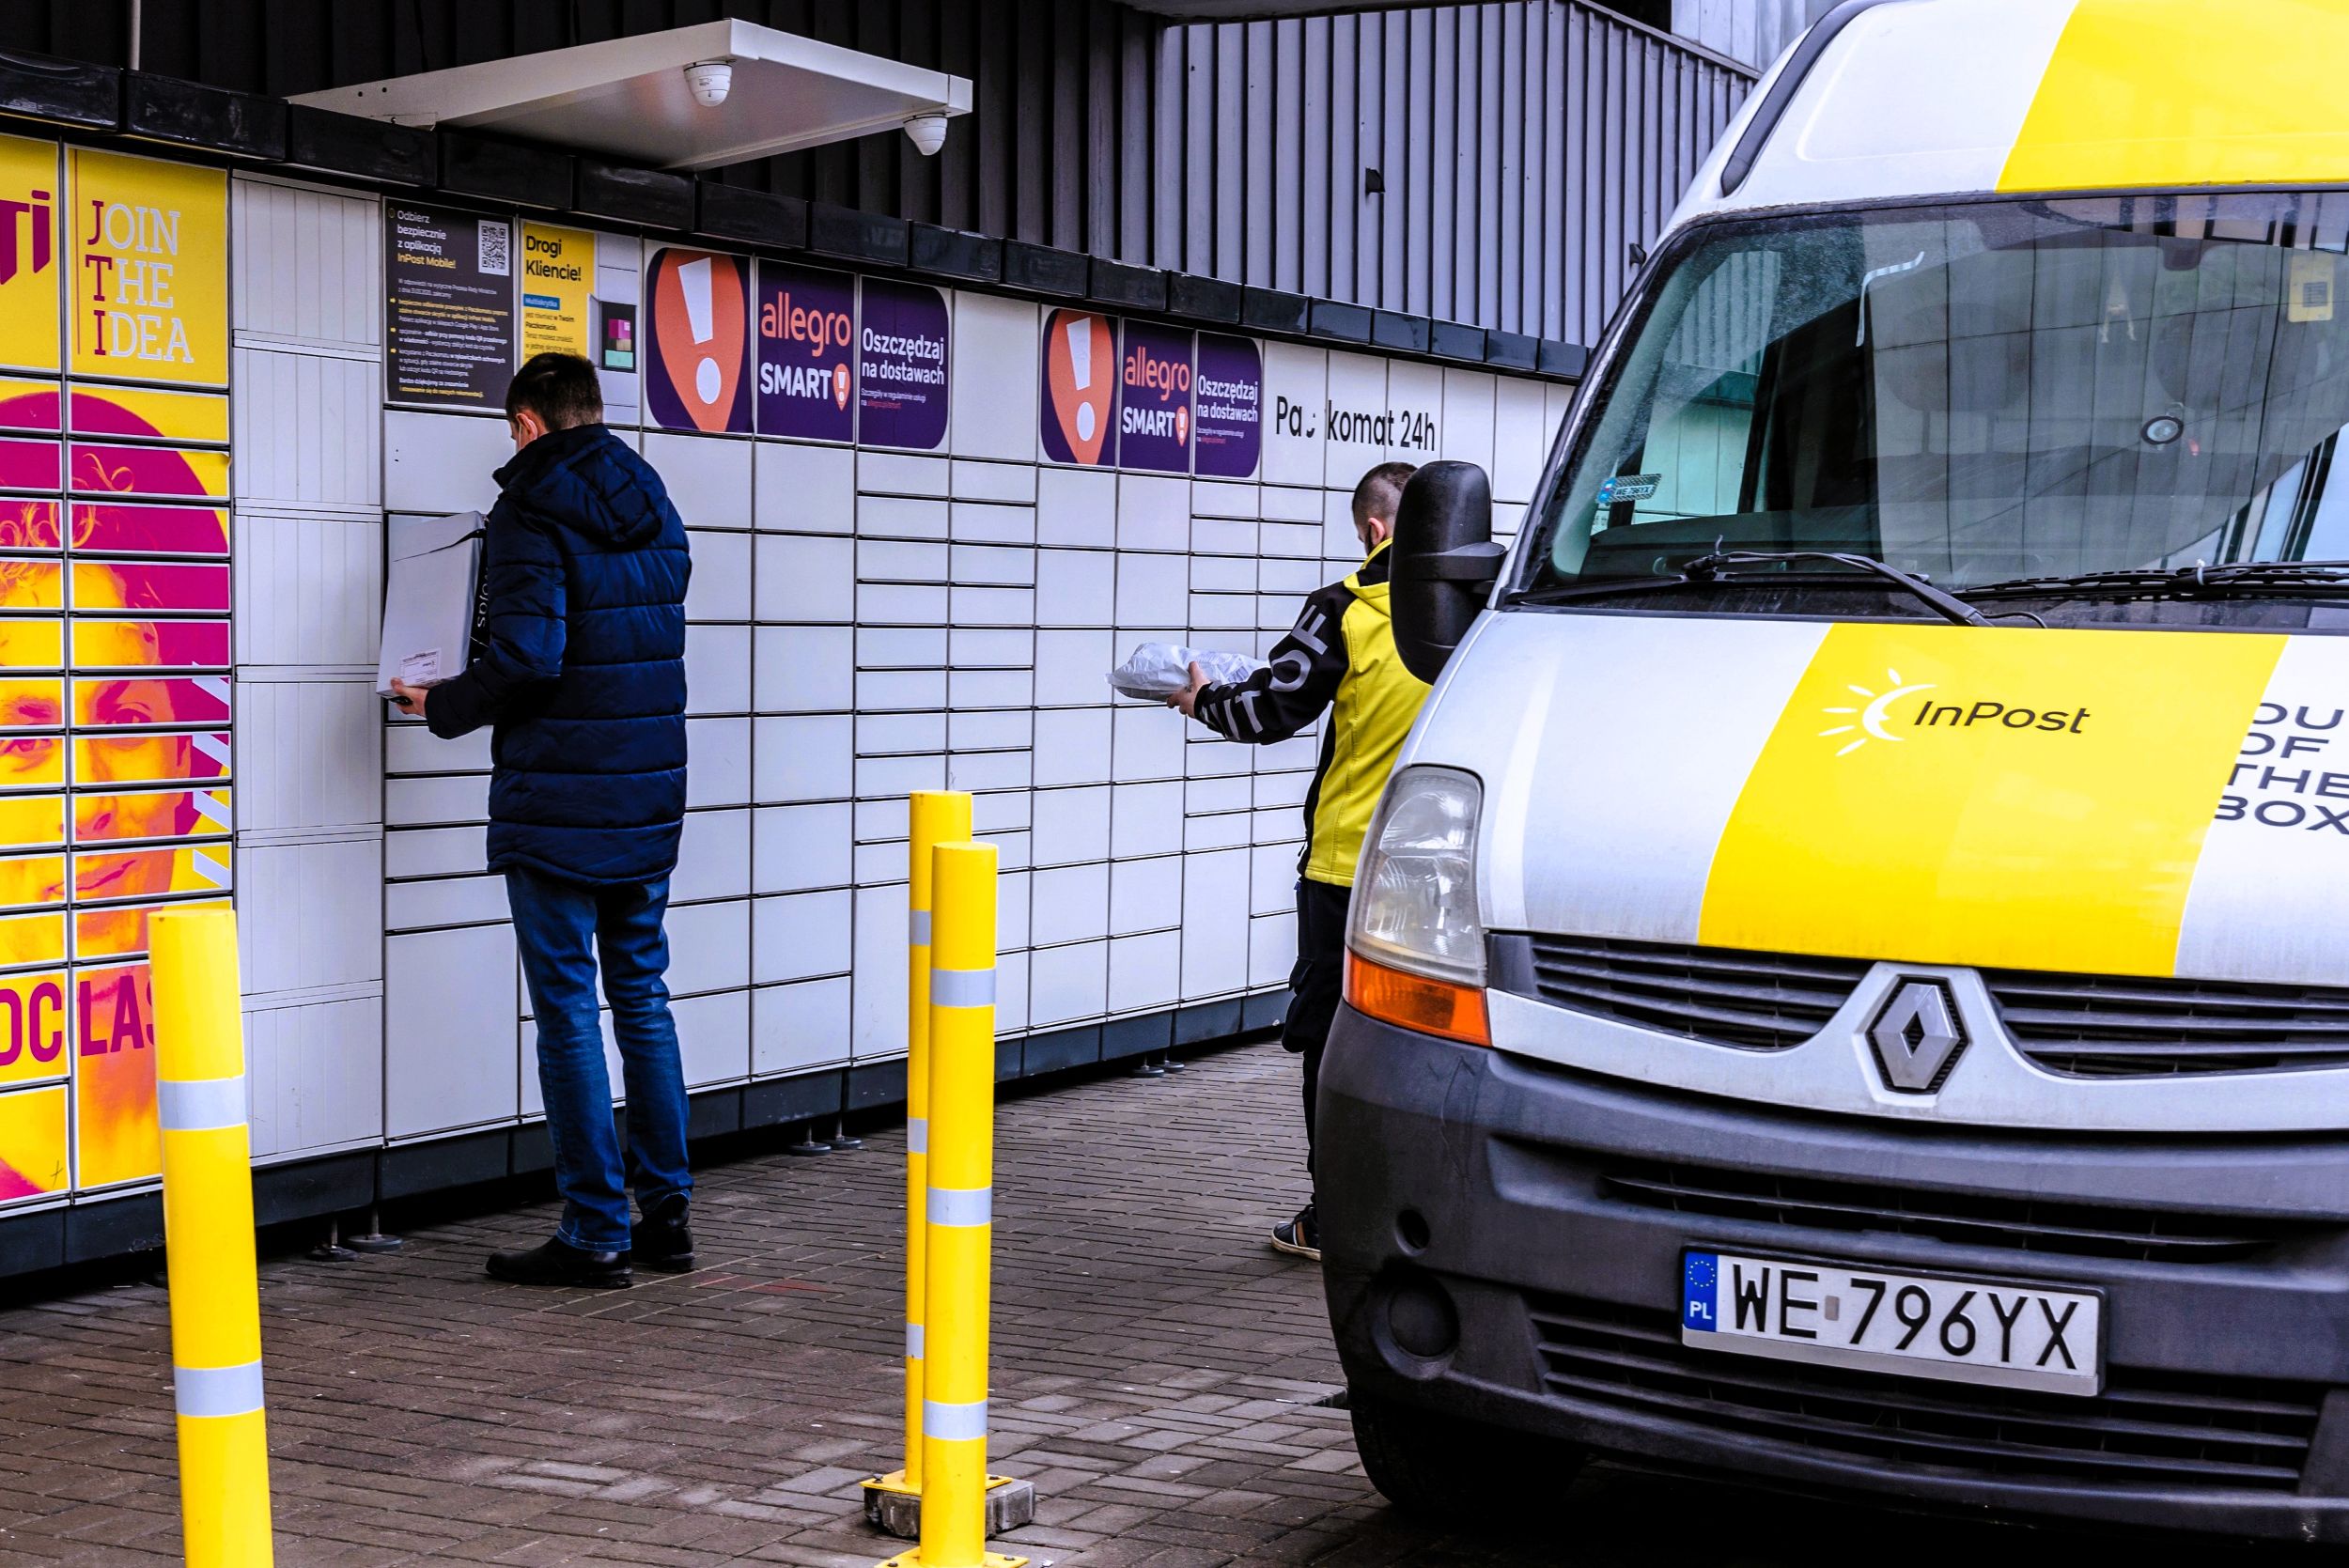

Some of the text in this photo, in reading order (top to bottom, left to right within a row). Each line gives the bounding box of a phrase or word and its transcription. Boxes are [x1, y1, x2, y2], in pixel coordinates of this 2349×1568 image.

[86, 200, 180, 256] JOIN
[397, 210, 430, 224] Odbierz
[397, 225, 446, 241] bezpiecznie
[397, 240, 443, 256] z aplikacją
[397, 253, 457, 270] InPost Mobile!
[525, 235, 562, 258] Drogi
[86, 254, 174, 309] THE
[525, 259, 582, 282] Kliencie!
[93, 309, 194, 364] IDEA
[761, 291, 851, 357] allegro
[863, 328, 944, 365] Oszczędzaj
[862, 360, 945, 385] na dostawach
[1125, 346, 1190, 401] allegro
[1198, 375, 1259, 405] Oszczędzaj
[1197, 402, 1259, 423] na dostawach
[1400, 411, 1436, 451] 24h
[1268, 604, 1329, 692] OF
[1913, 700, 2091, 735] InPost
[1689, 1301, 1713, 1320] PL
[1733, 1263, 2079, 1371] WE 796YX
